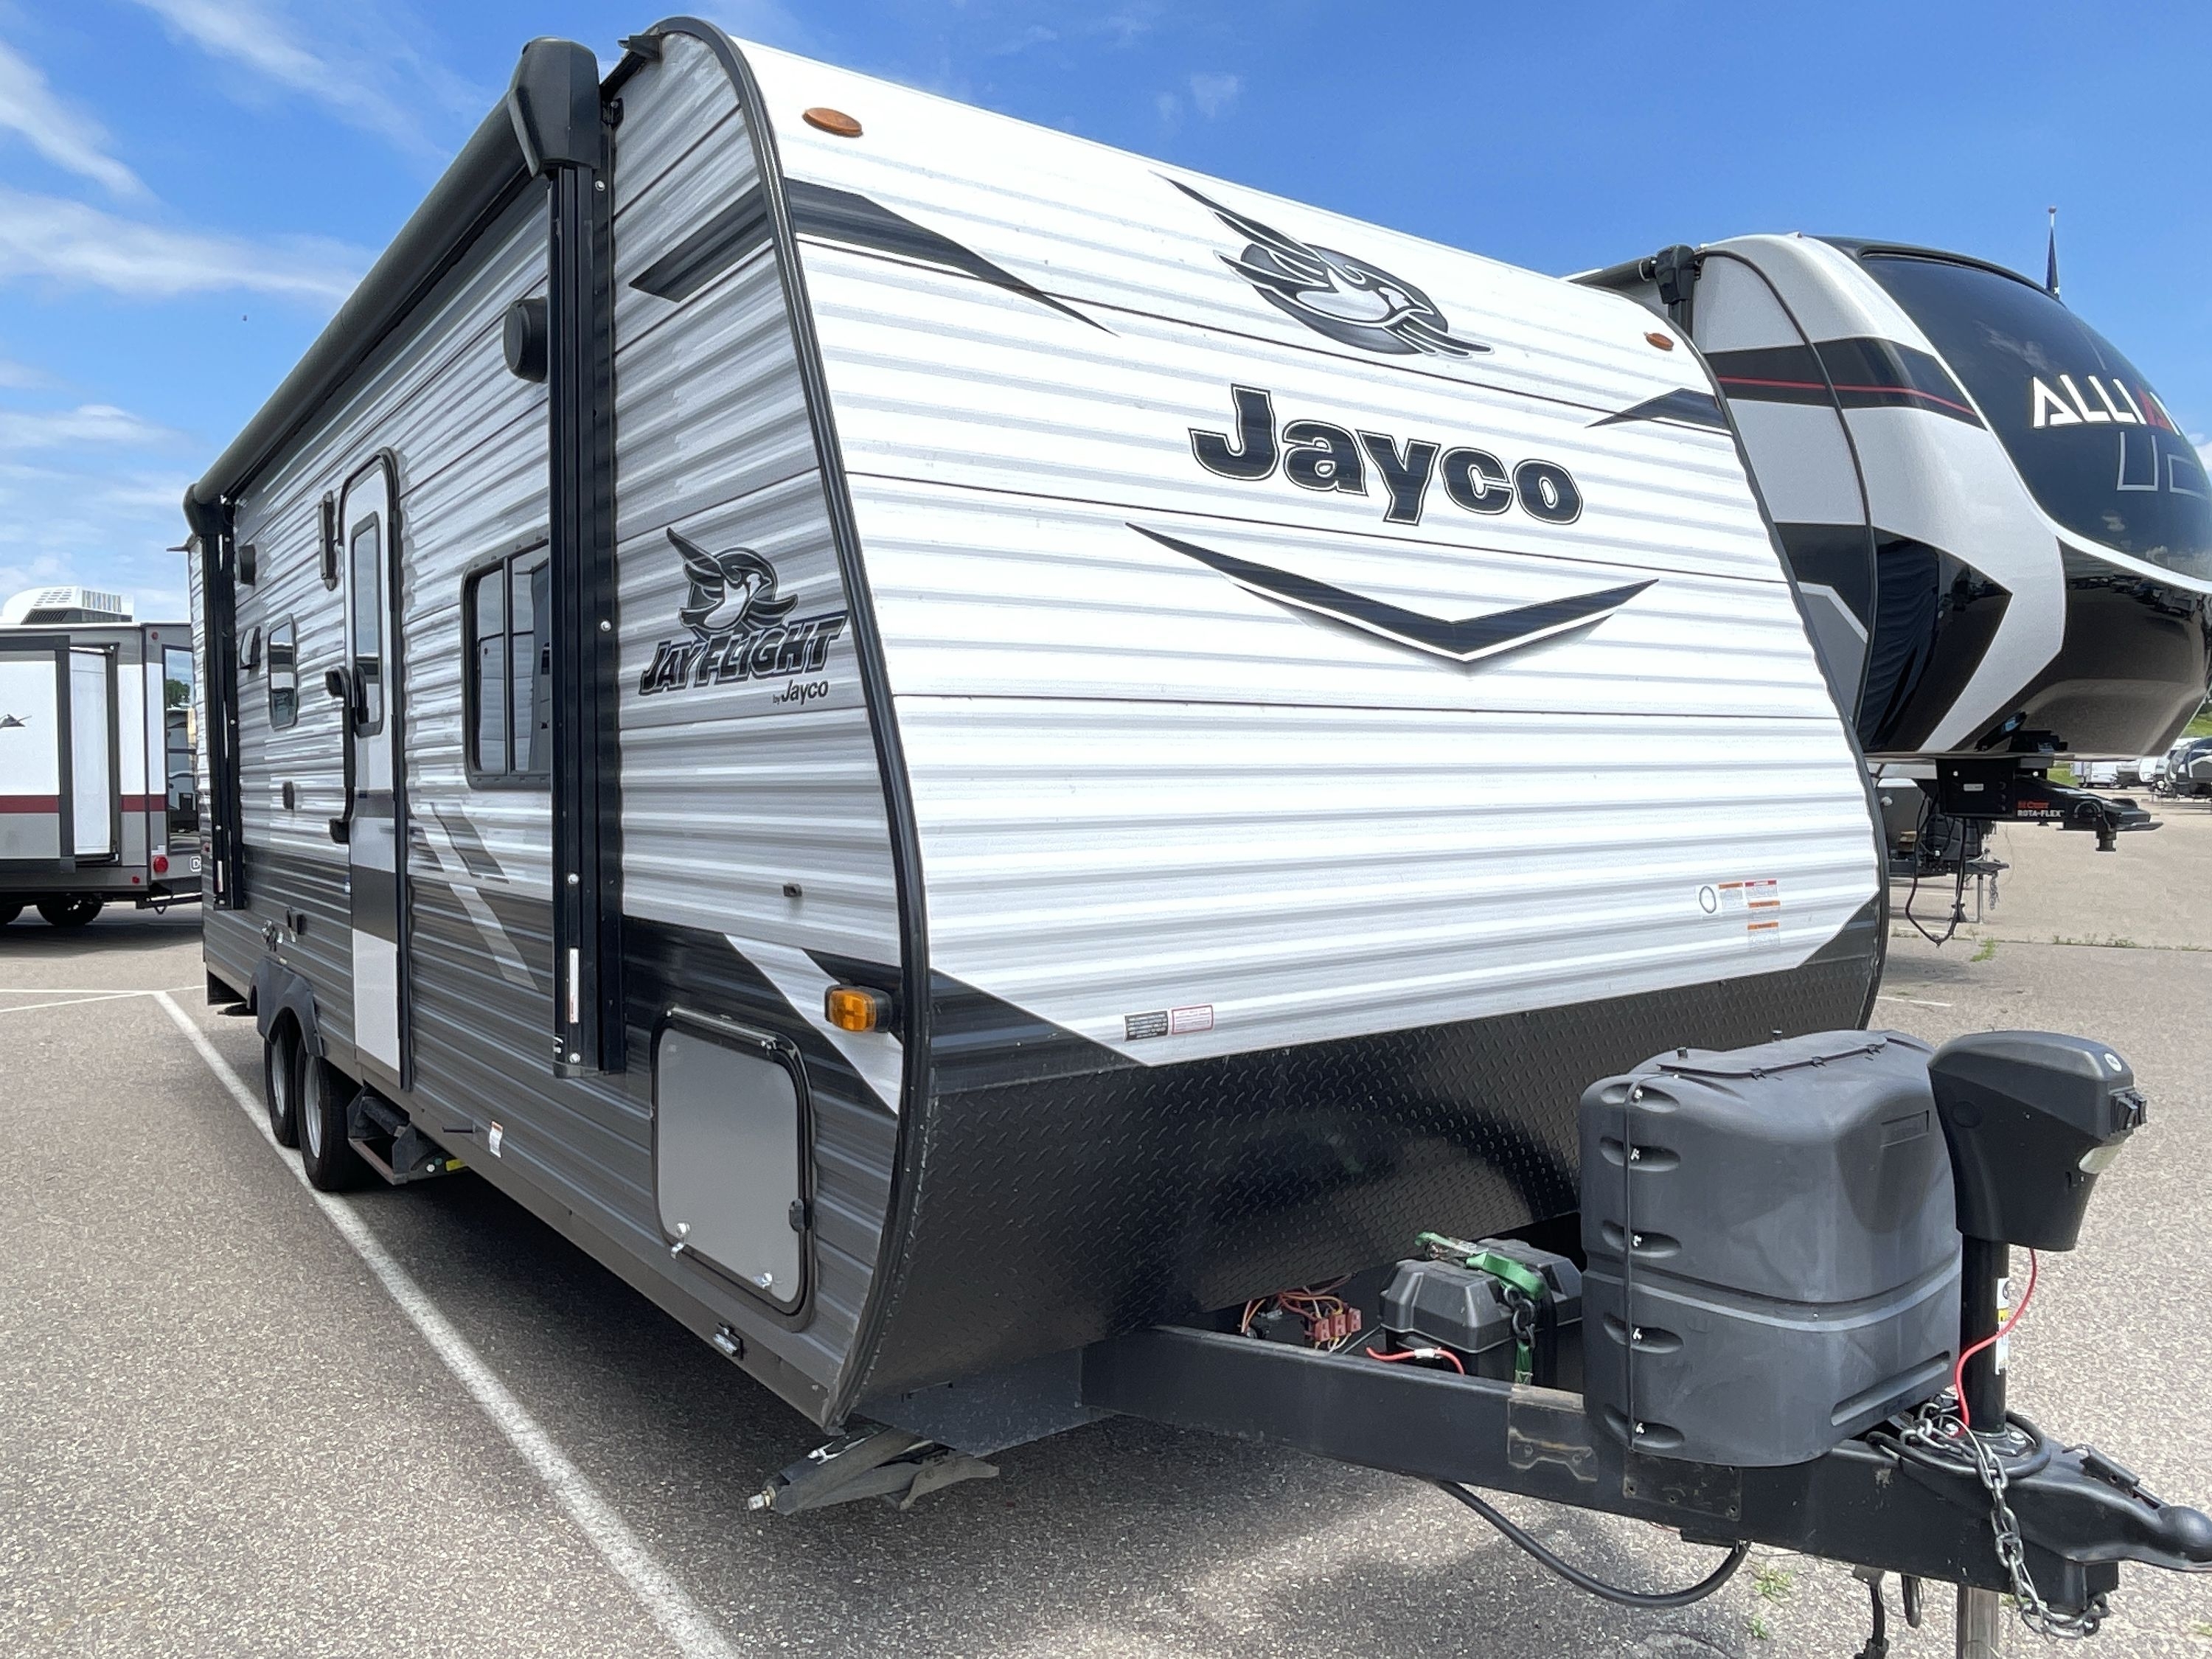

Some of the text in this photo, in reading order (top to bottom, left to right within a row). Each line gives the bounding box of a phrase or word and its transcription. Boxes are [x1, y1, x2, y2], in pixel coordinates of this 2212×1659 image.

[2032, 374, 2180, 436] ALLIA
[1188, 383, 1583, 526] Jayco
[782, 678, 829, 706] Jayco
